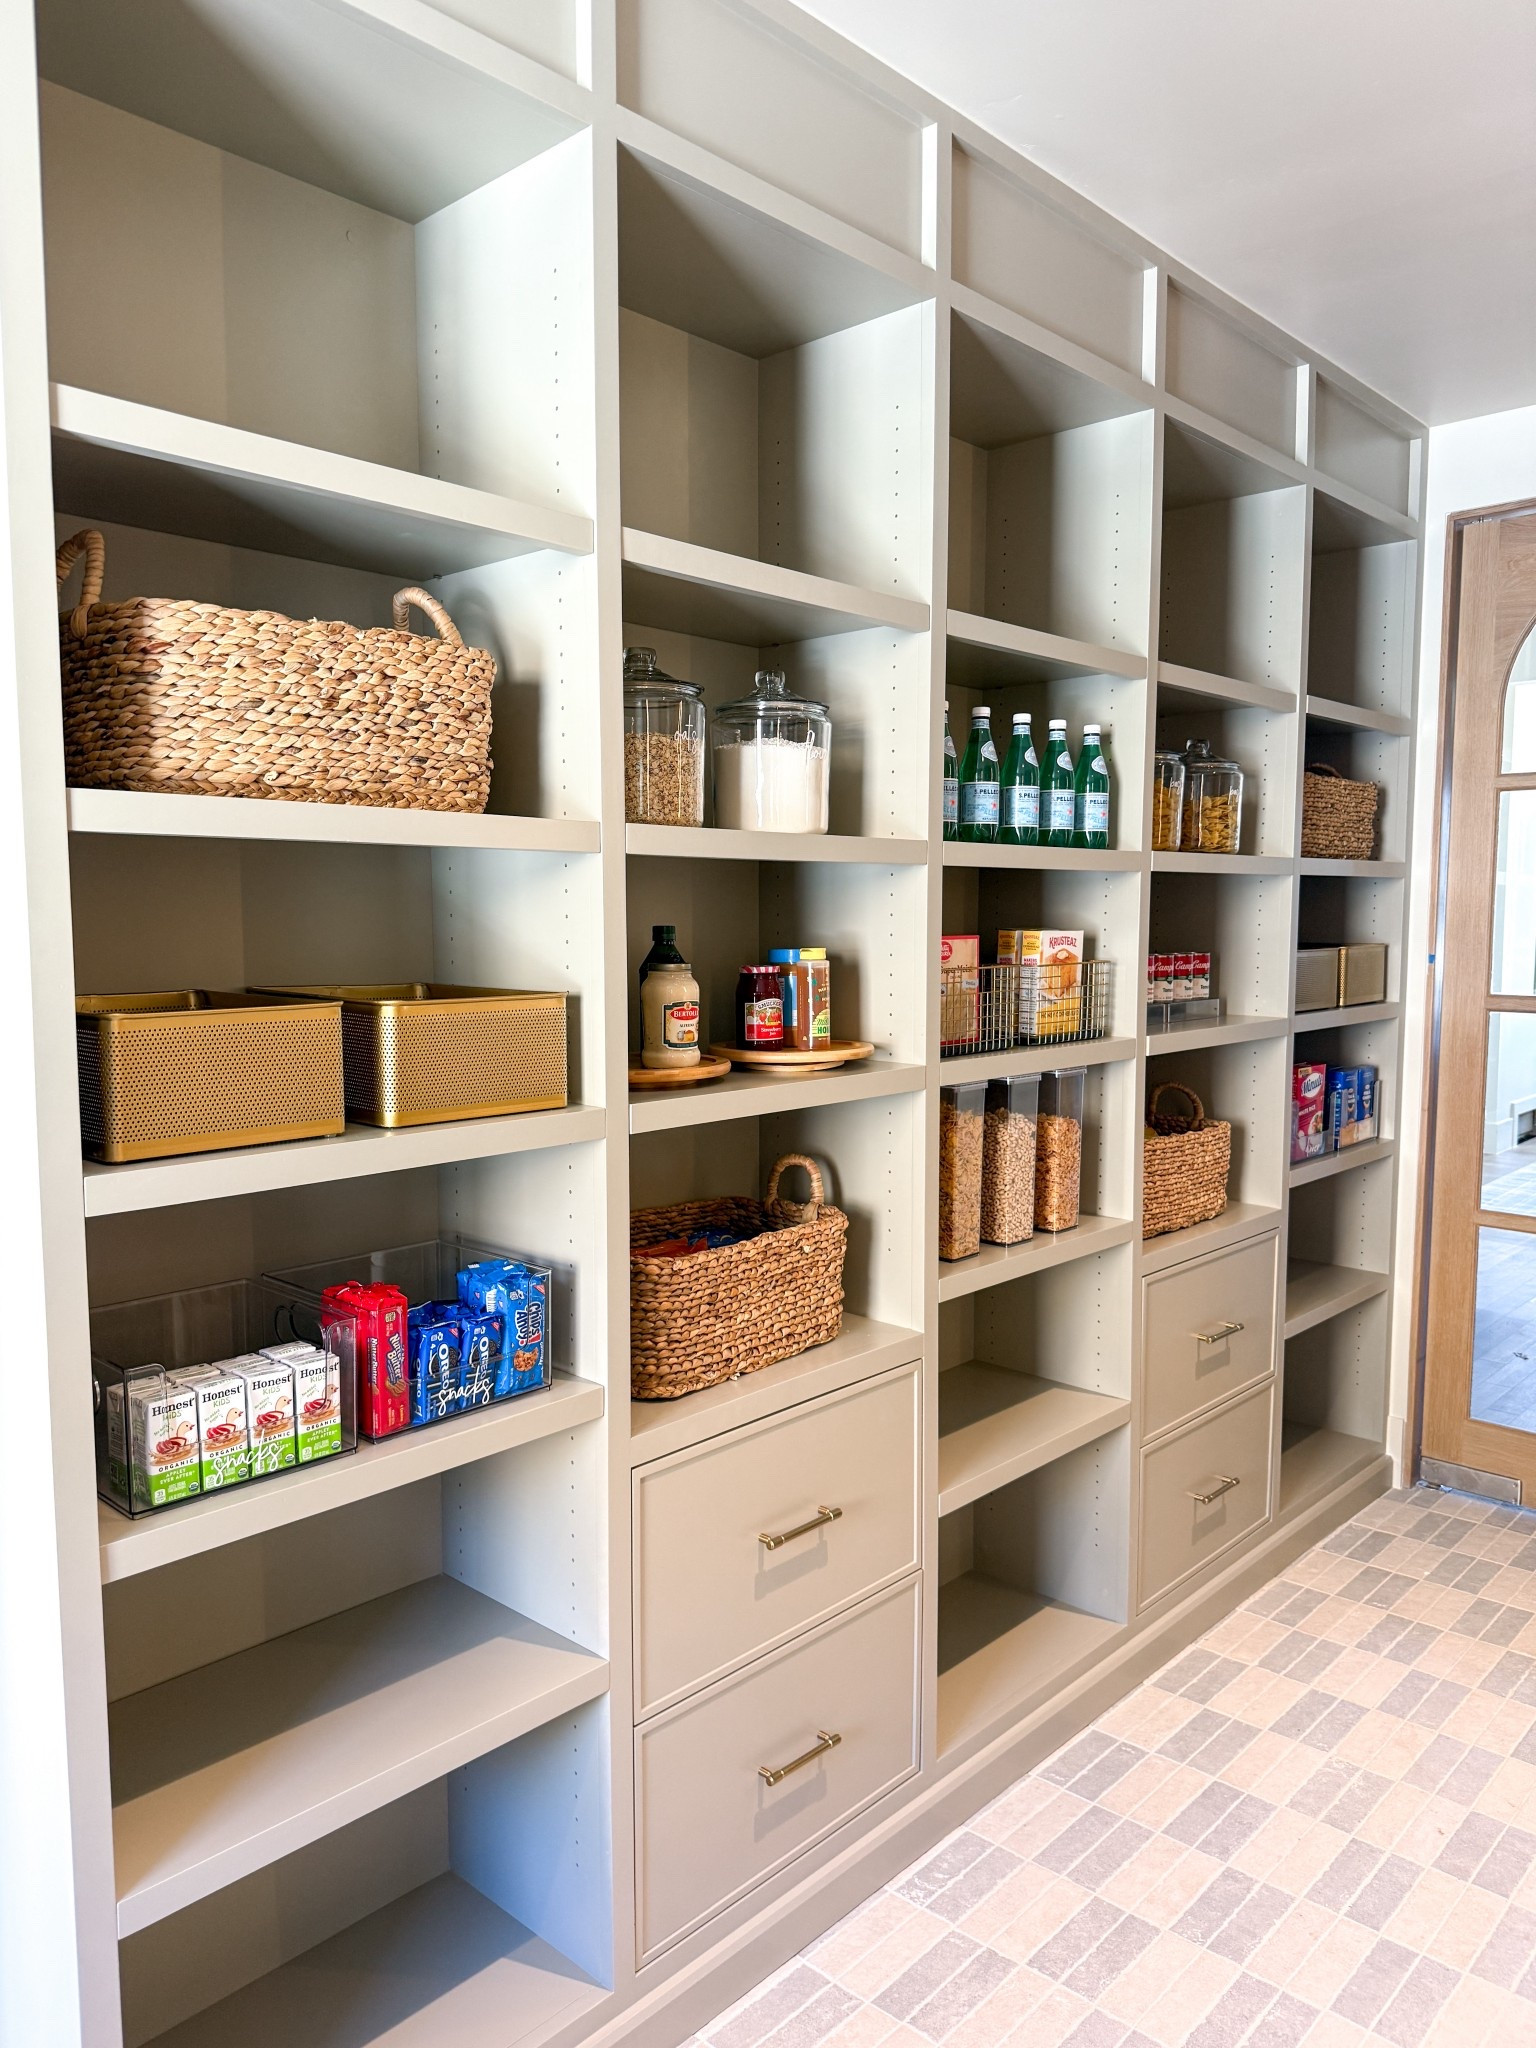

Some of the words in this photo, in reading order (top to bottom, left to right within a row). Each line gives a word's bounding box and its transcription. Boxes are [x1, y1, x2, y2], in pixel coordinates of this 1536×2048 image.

[674, 714, 699, 754] oats
[1049, 935, 1077, 949] KRUSTEAZ
[387, 1350, 402, 1379] Butter
[439, 1343, 450, 1390] OREO
[480, 1336, 489, 1380] OREO
[252, 1374, 292, 1391] Honest
[438, 1364, 495, 1416] snacks
[202, 1385, 242, 1403] Honest
[152, 1398, 194, 1417] Honest
[306, 1419, 336, 1431] ORGANIC
[209, 1444, 243, 1458] ORGANIC
[213, 1428, 285, 1487] snacks
[158, 1458, 194, 1472] ORGANIC
